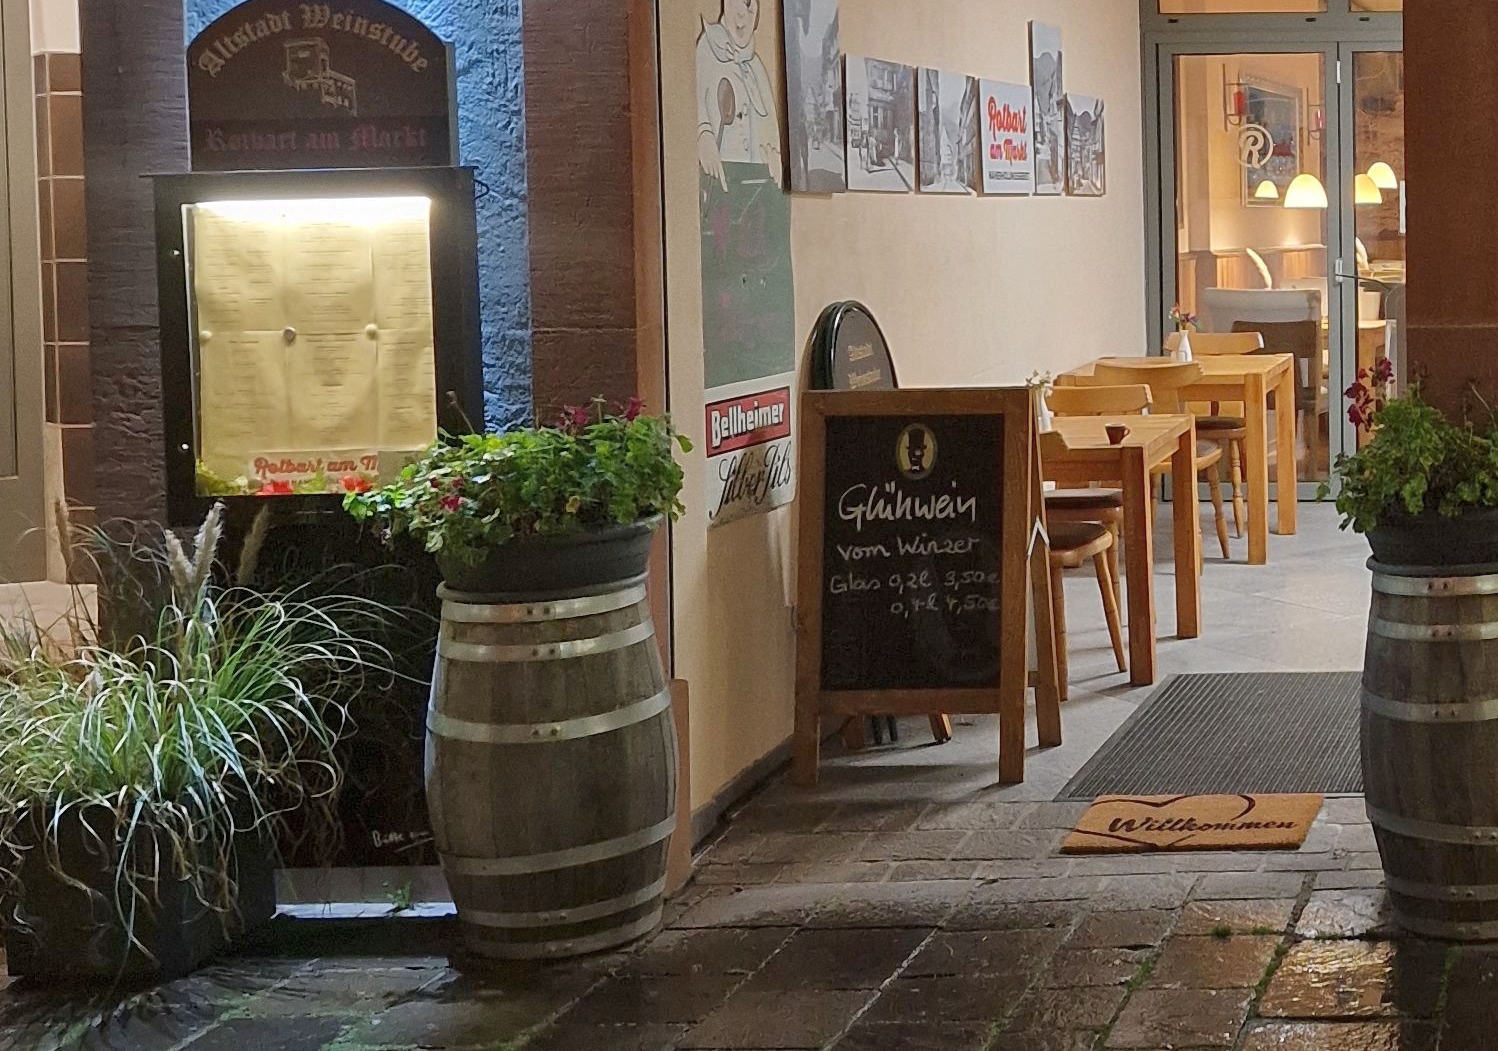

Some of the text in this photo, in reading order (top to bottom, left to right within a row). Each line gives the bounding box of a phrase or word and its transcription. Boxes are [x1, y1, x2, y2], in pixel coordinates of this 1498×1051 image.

[198, 2, 430, 79] Altstadt Weinstube
[987, 95, 1028, 142] Rotbart
[711, 405, 785, 448] Bellheimer
[326, 459, 358, 472] am
[838, 480, 977, 532] Glühwein
[836, 532, 981, 561] vom Winzer
[829, 572, 881, 594] Glas
[1108, 816, 1298, 835] Willkommen
